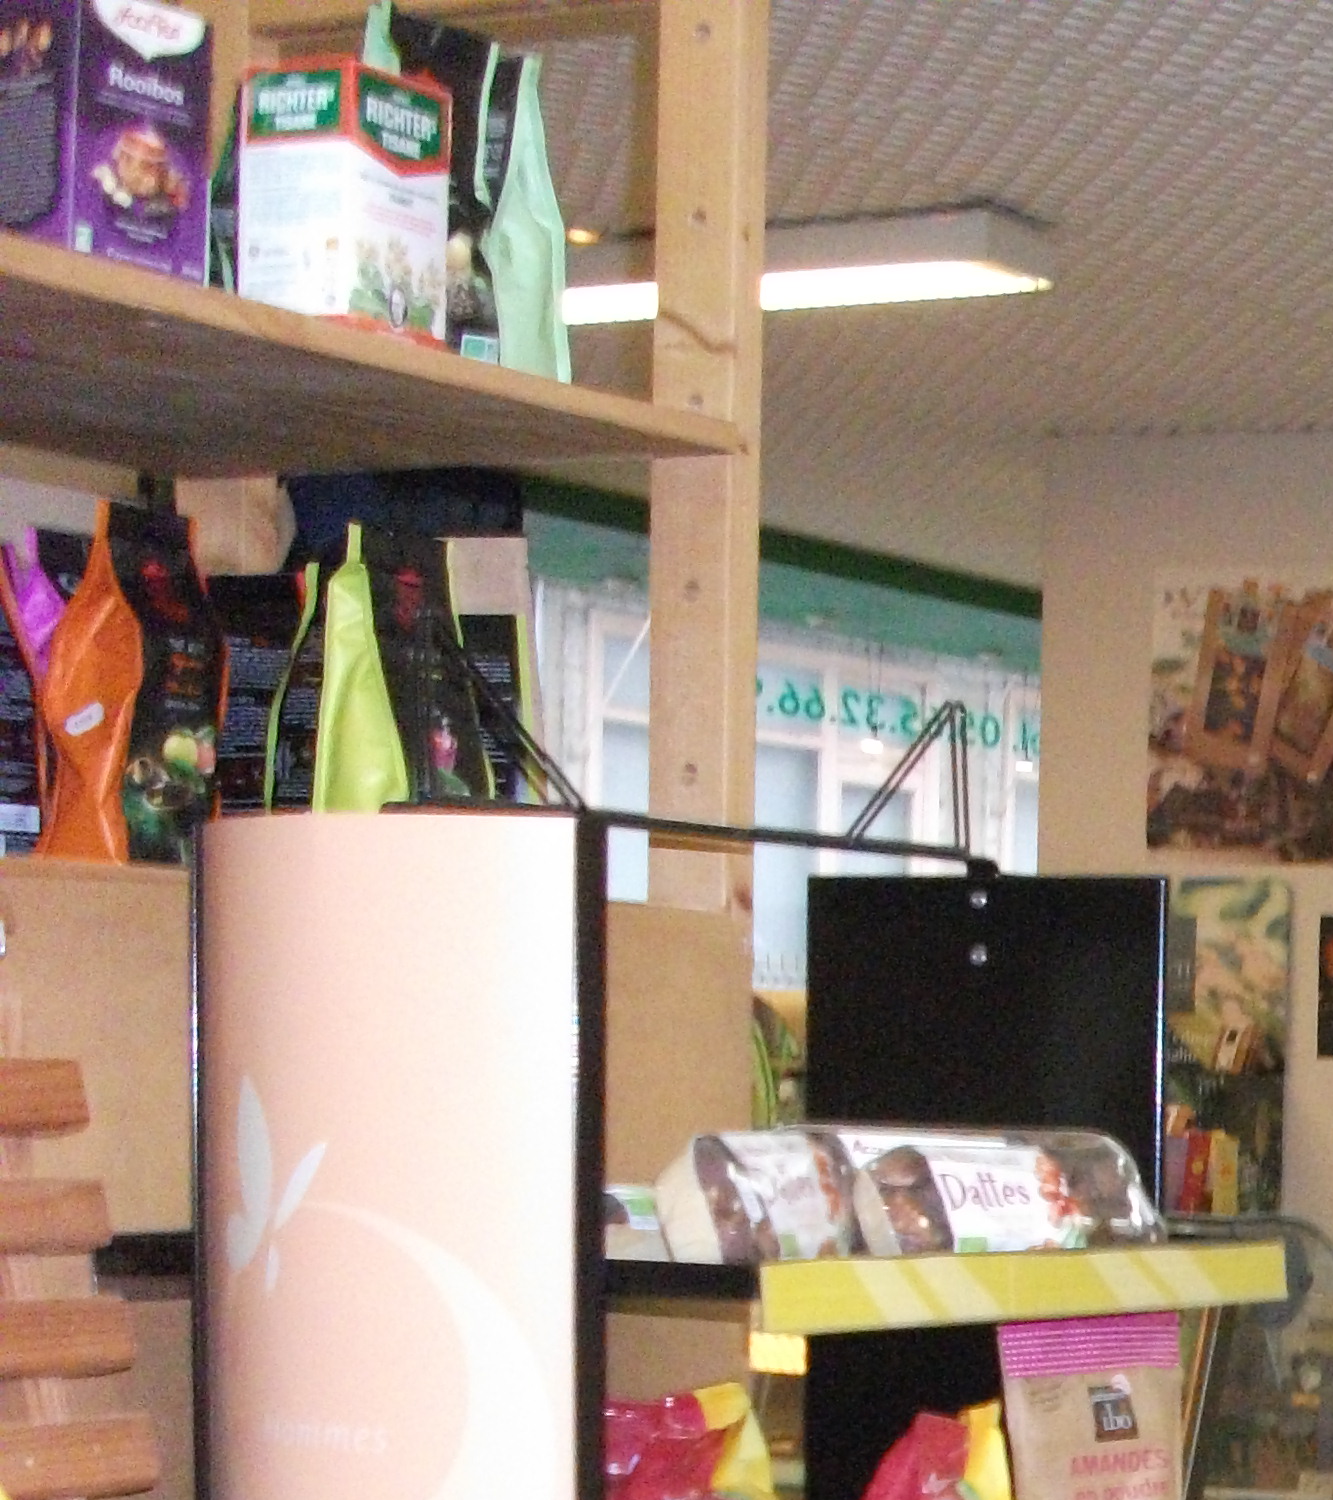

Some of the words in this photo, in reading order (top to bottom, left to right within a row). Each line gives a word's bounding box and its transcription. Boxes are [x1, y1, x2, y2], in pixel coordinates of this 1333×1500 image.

[108, 62, 184, 106] Rooibos
[941, 1170, 1031, 1213] Dattes
[1071, 1450, 1169, 1475] AMANDES
